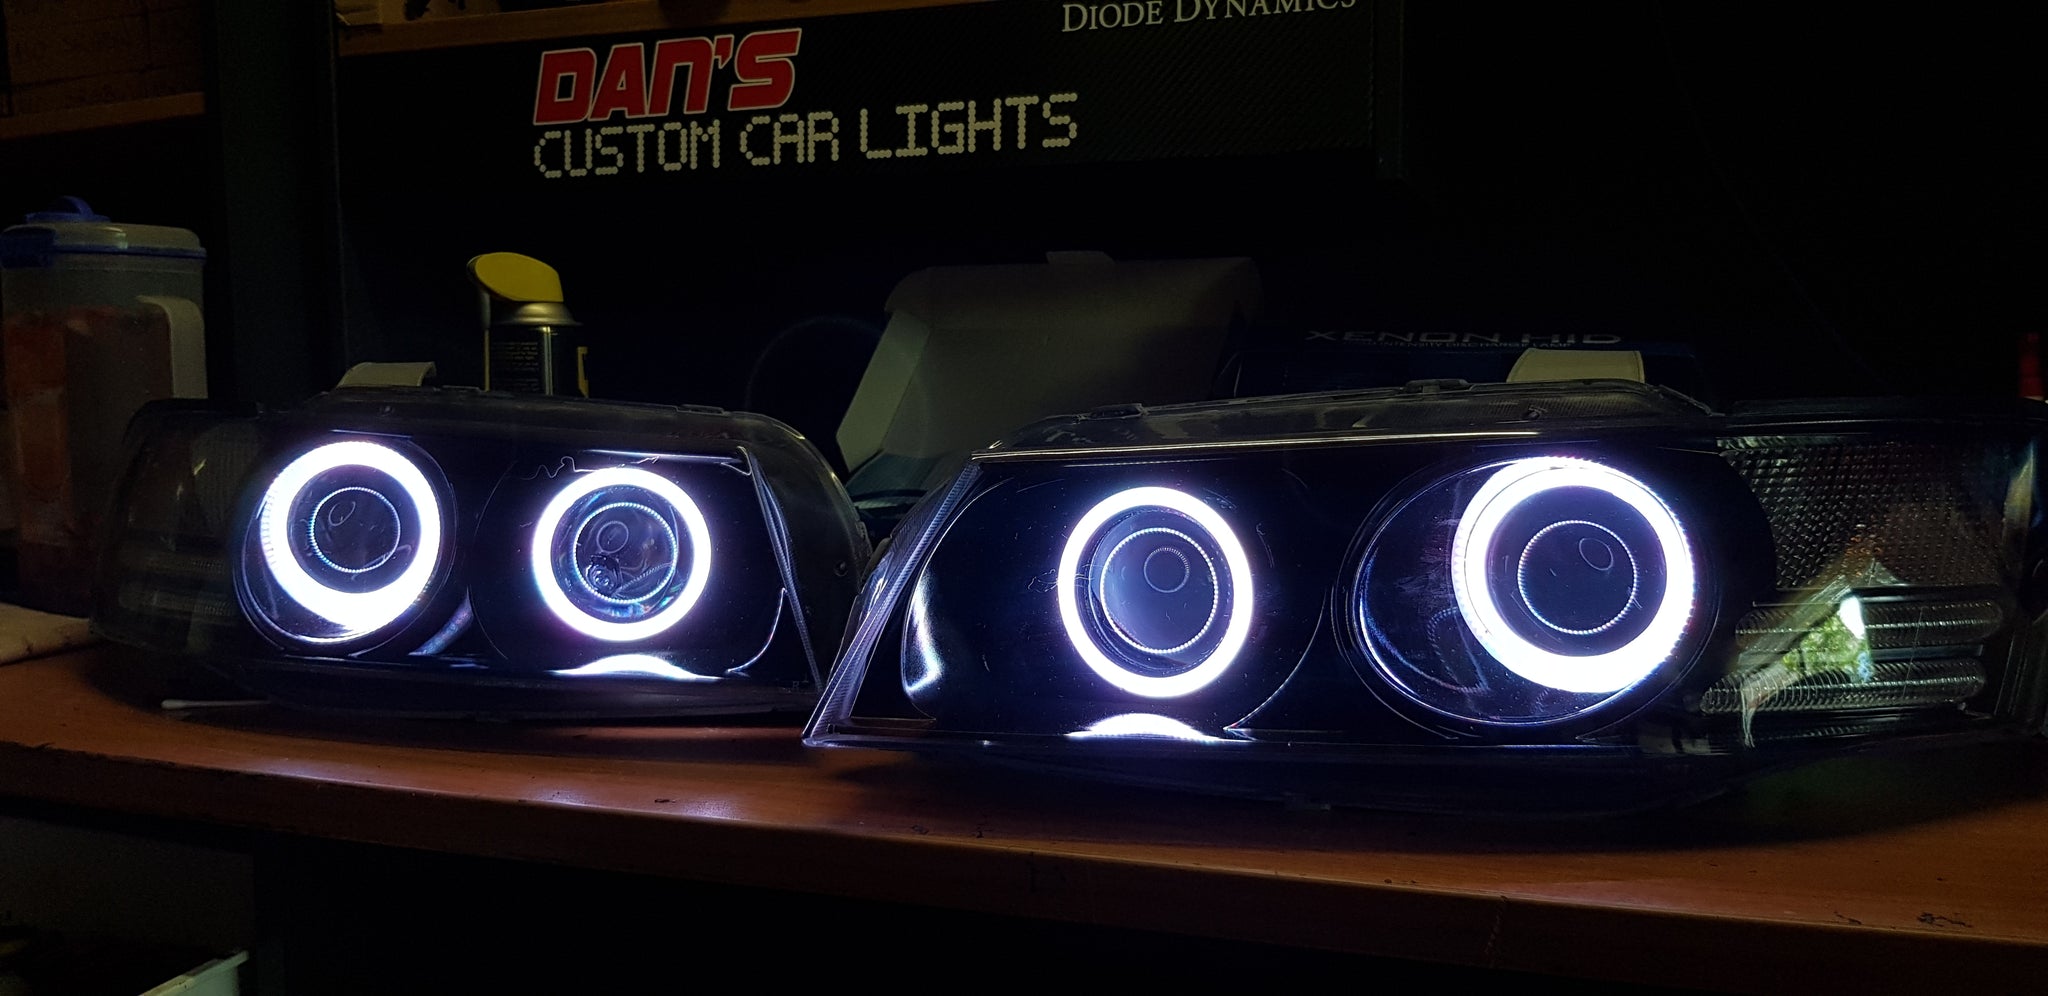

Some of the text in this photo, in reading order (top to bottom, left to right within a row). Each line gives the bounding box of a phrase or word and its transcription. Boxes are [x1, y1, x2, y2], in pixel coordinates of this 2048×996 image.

[1061, 1, 1163, 32] DIODE
[533, 27, 803, 126] DAN'S
[533, 91, 1080, 179] CUSTOM CAR LIGHTS
[1304, 330, 1500, 344] XENON
[1520, 333, 1622, 345] HID
